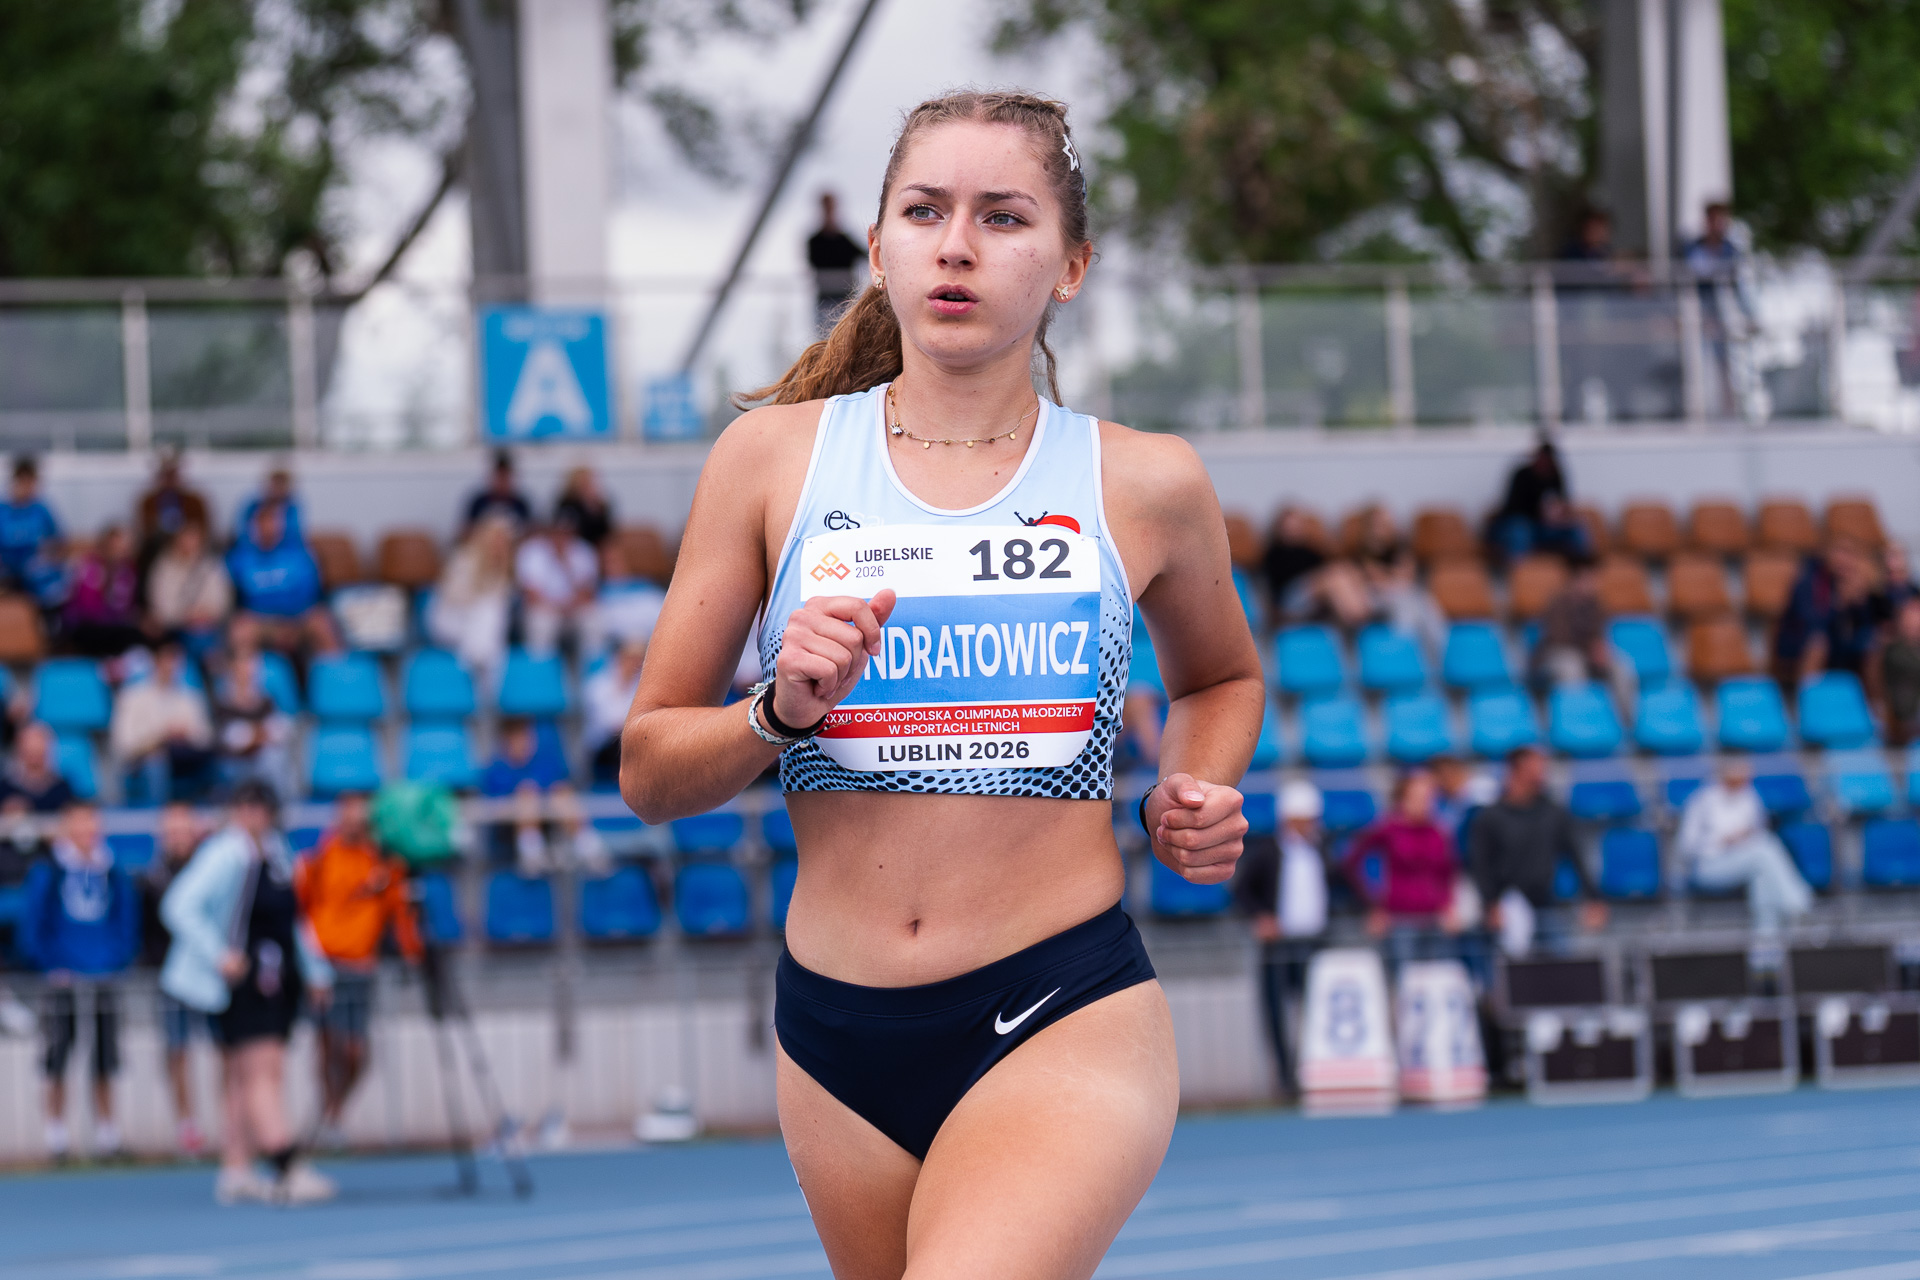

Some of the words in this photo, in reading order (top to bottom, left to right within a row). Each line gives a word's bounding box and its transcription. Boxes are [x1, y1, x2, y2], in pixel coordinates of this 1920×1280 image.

[505, 341, 596, 435] A
[855, 547, 934, 563] LUBELSKIE
[968, 538, 1072, 582] 182
[855, 565, 885, 578] 2026
[864, 620, 1090, 681] NDRATOWICZ
[854, 709, 952, 723] OGÓLNOPOLSKA
[954, 708, 1020, 720] OLIMPIADA
[1022, 705, 1084, 718] MŁODZIEŻY
[888, 724, 902, 735] W
[903, 723, 969, 735] SPORTACH
[971, 721, 1020, 733] LETNICH
[878, 743, 962, 763] LUBLIN
[969, 741, 1030, 760] 2026
